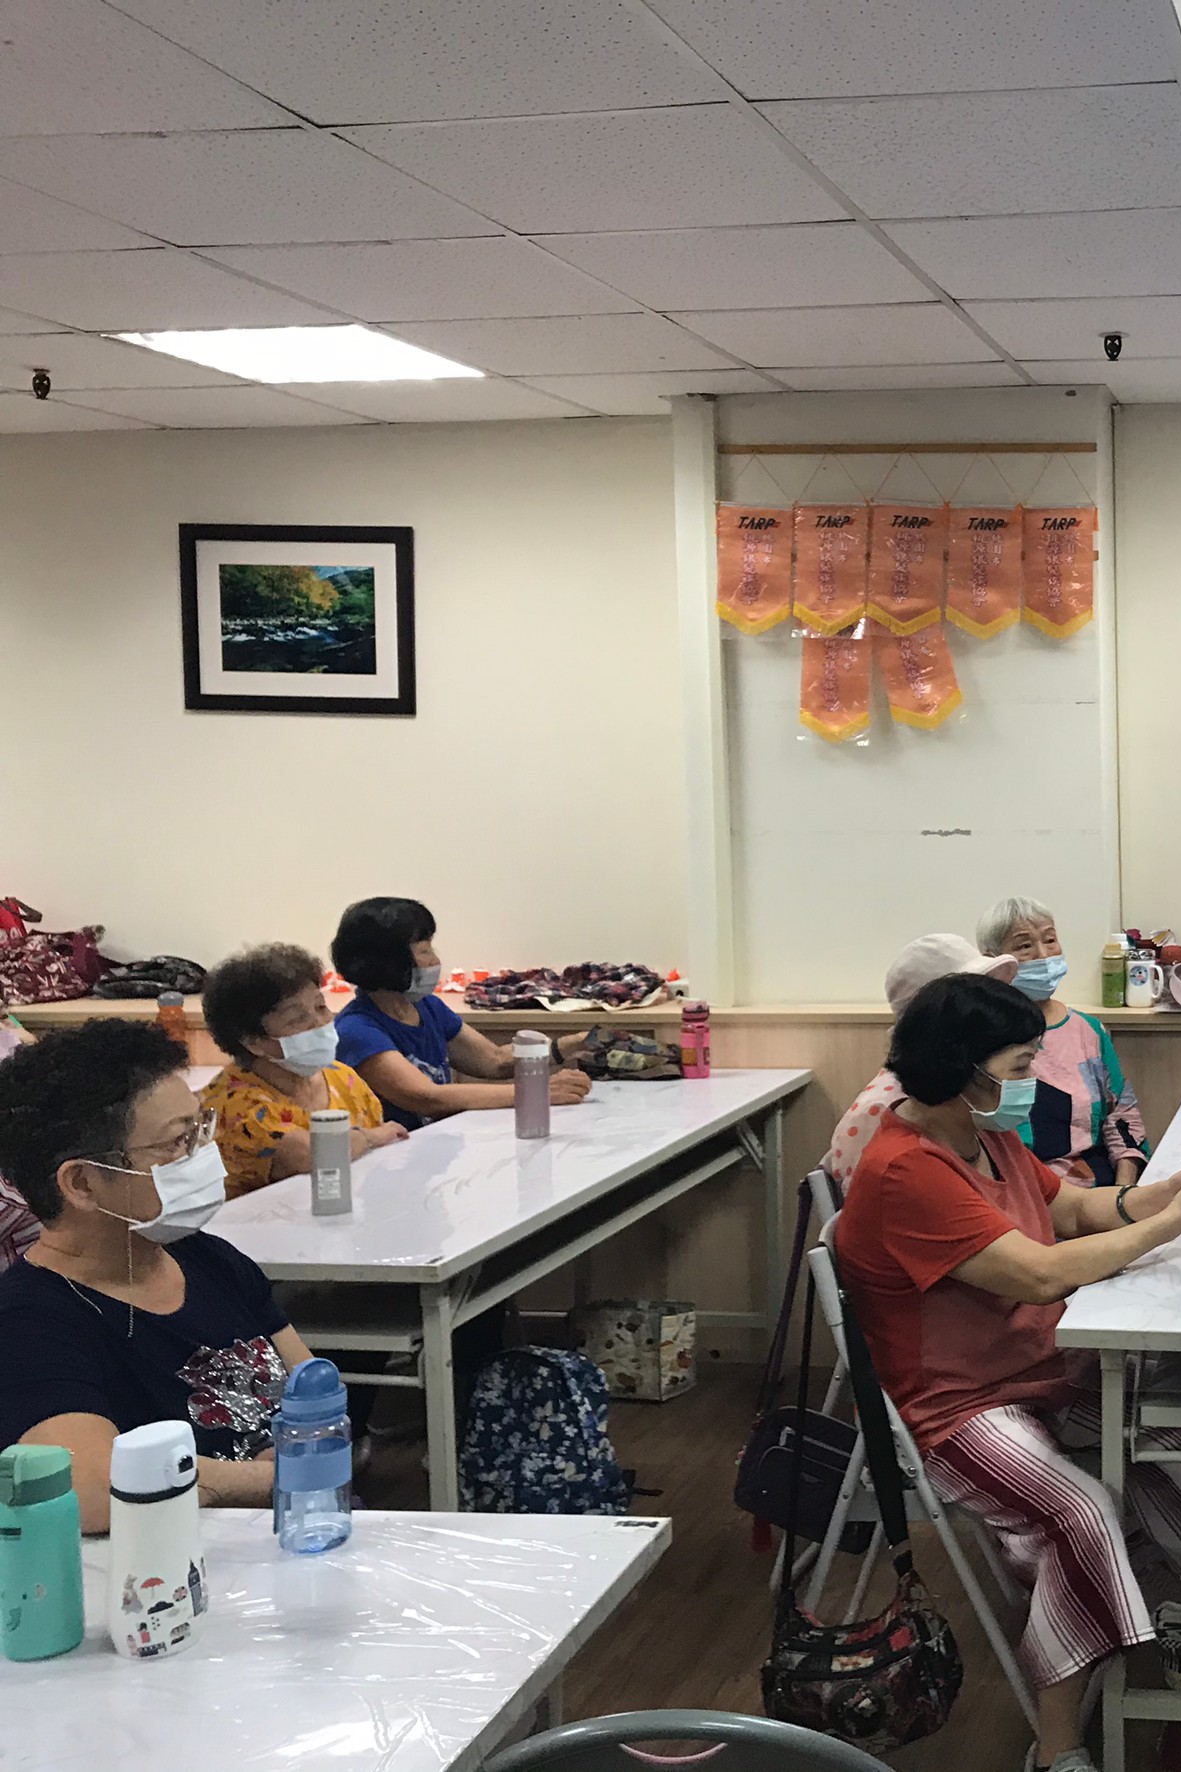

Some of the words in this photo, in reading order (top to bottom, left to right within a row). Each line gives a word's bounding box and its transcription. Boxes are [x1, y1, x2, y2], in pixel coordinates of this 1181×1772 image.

[737, 516, 776, 530] TARP
[815, 515, 851, 528] TARP
[891, 514, 930, 529] TARP
[967, 517, 1006, 530] TARP
[1041, 517, 1077, 530] TARP
